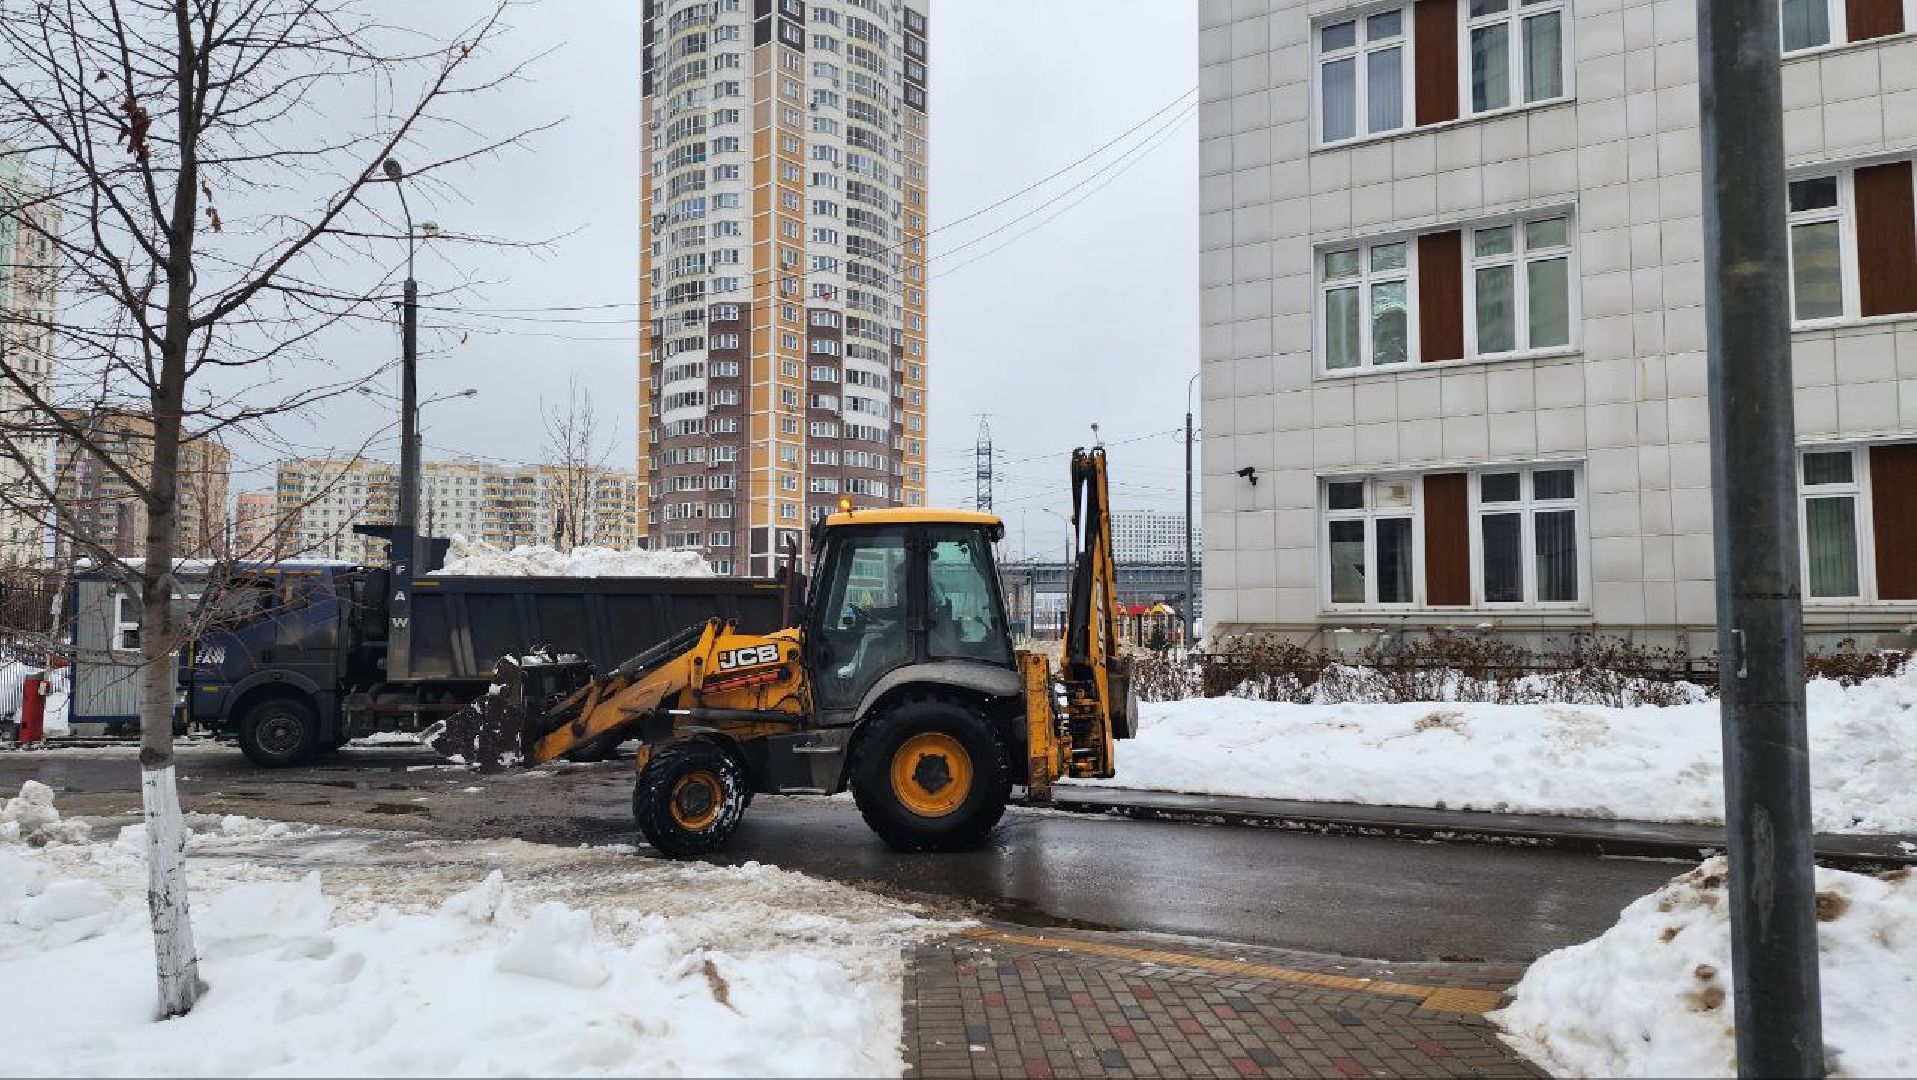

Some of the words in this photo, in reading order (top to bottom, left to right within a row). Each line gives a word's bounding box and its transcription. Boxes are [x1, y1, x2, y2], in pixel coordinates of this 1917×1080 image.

[393, 565, 408, 628] FAW
[195, 655, 225, 664] FAW
[720, 645, 778, 669] JCB
